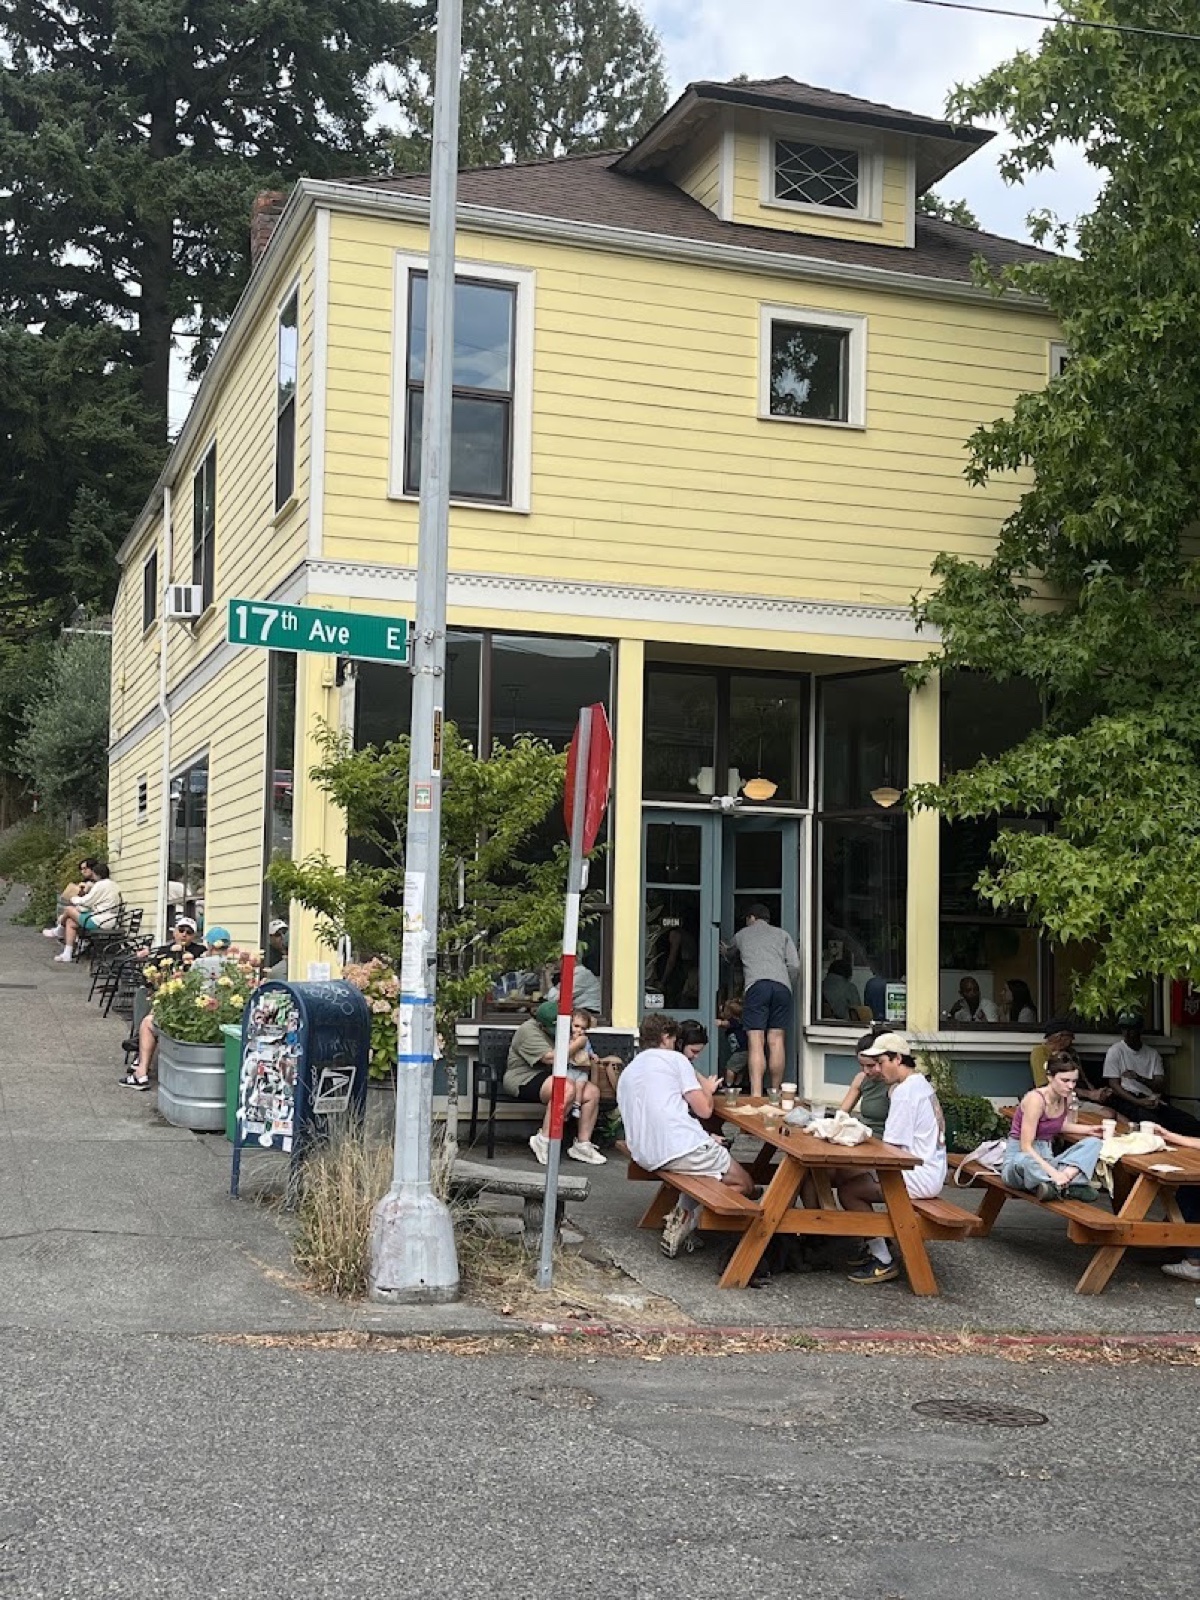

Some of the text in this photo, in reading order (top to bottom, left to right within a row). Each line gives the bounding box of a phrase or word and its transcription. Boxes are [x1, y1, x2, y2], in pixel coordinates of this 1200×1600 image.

[236, 605, 401, 650] 17th Ave E
[662, 918, 680, 927] OPEN
